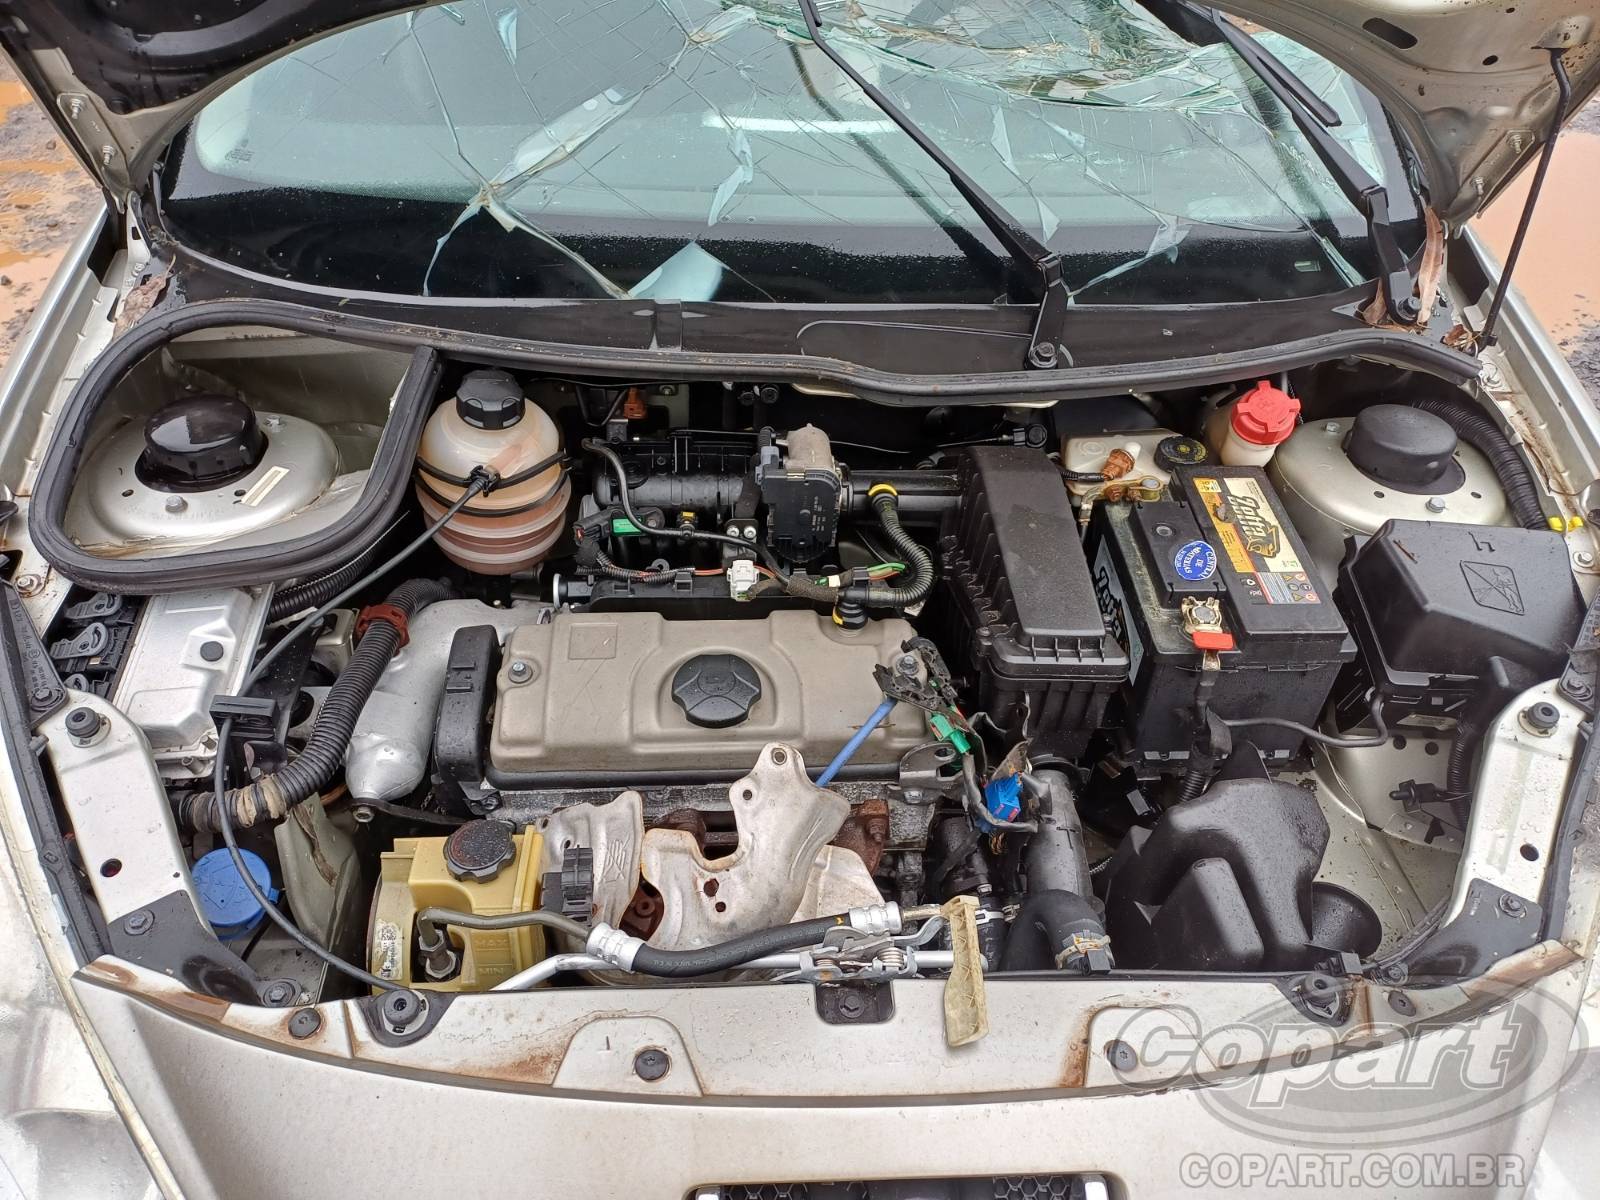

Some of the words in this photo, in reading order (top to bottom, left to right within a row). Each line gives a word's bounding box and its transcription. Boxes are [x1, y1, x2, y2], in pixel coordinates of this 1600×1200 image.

[1195, 559, 1204, 568] DE
[1199, 551, 1215, 578] CENTRAL
[479, 967, 504, 976] MIN
